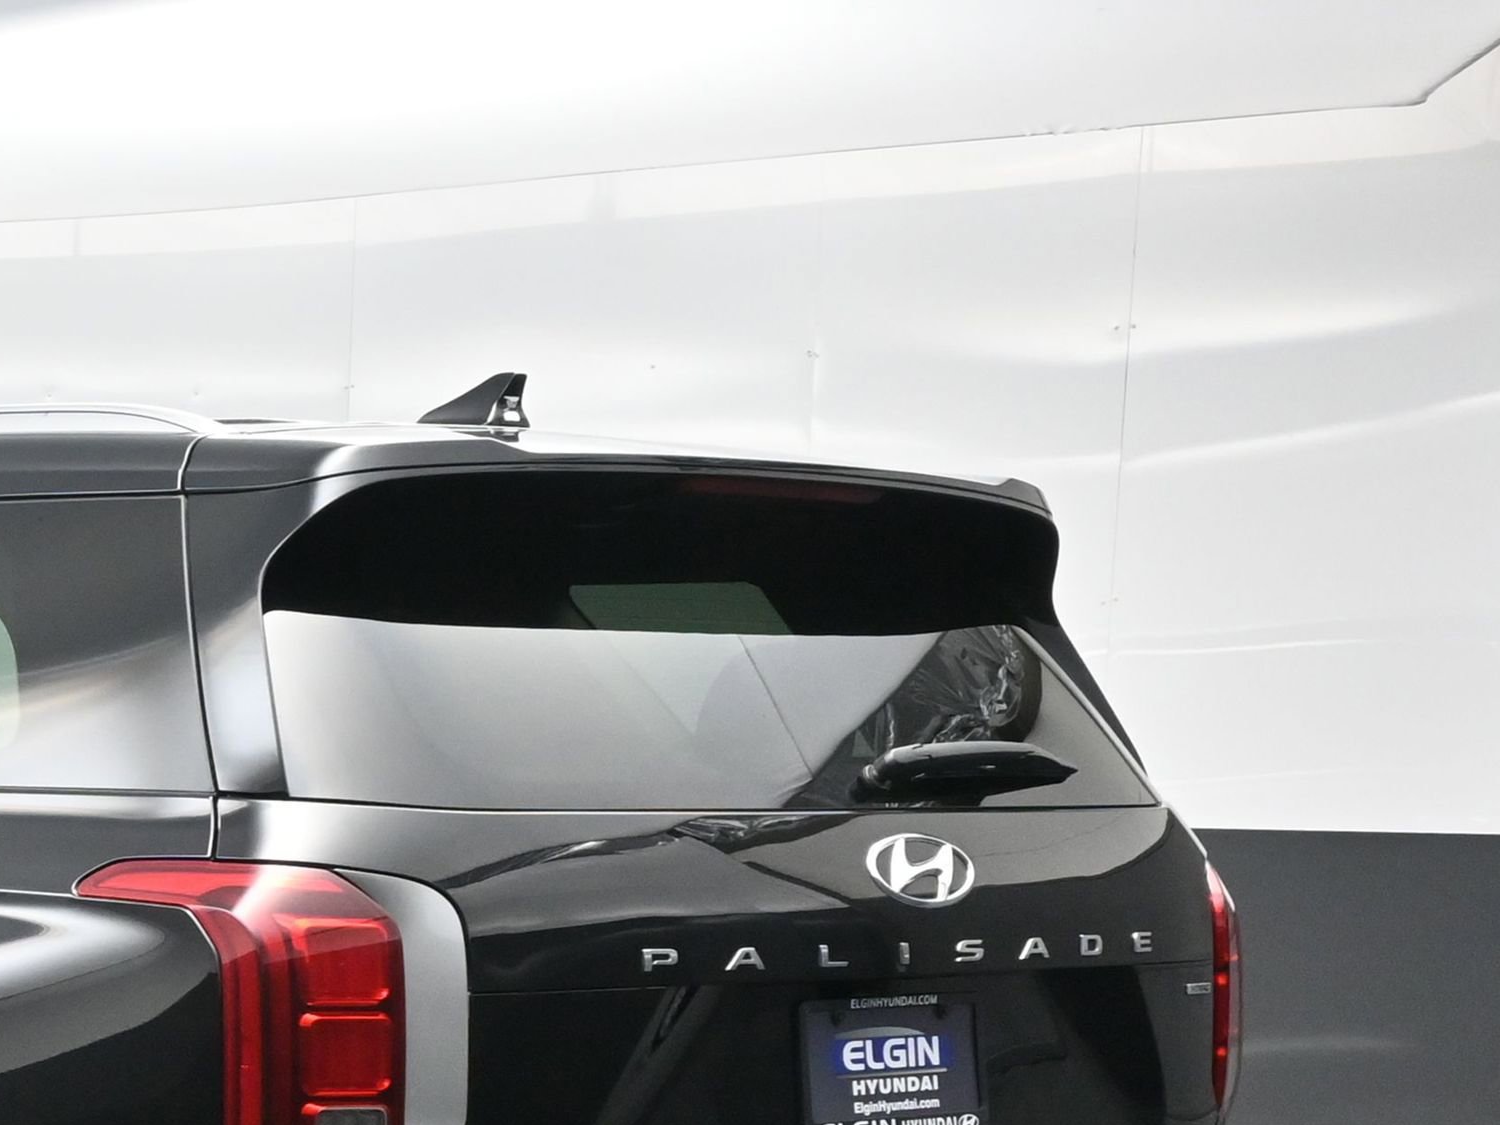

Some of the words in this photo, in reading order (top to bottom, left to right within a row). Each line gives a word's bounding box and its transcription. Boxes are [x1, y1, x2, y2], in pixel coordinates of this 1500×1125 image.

[641, 930, 1153, 973] PALISADE
[850, 994, 938, 1010] ELGINHYUNDAI.COM
[842, 1035, 941, 1072] ELGIN
[852, 1074, 939, 1097] HYUNDAI
[853, 1097, 940, 1117] ElginHyundai.com
